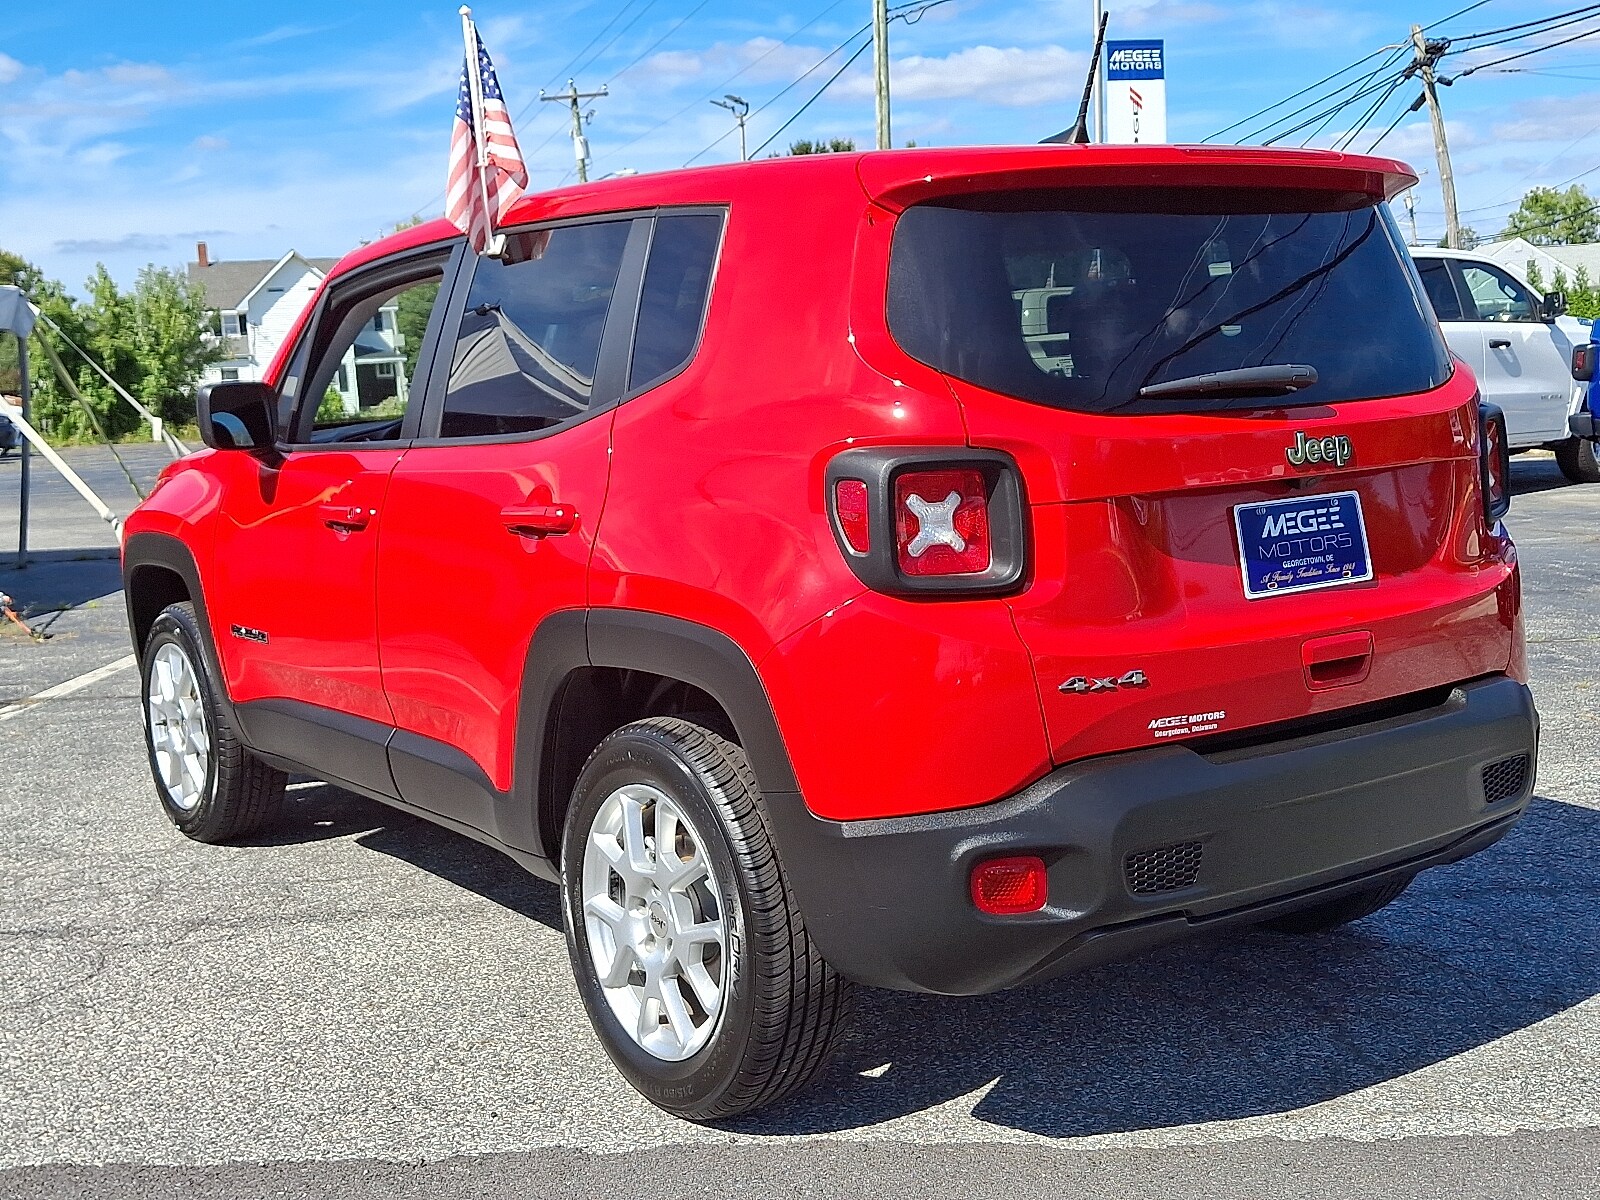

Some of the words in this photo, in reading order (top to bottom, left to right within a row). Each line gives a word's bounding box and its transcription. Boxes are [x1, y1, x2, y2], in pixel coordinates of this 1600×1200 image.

[1109, 49, 1161, 62] MEGEE
[1109, 62, 1162, 71] MOTORS
[1285, 430, 1352, 467] Jeep
[1261, 506, 1345, 539] MEGEE
[1258, 532, 1353, 560] MOTORS
[1282, 555, 1326, 569] GEORGETOWN,
[1325, 554, 1335, 562] DE
[1057, 669, 1148, 691] 4x4
[1147, 715, 1189, 730] MEGEE
[1188, 710, 1226, 724] MOTORS
